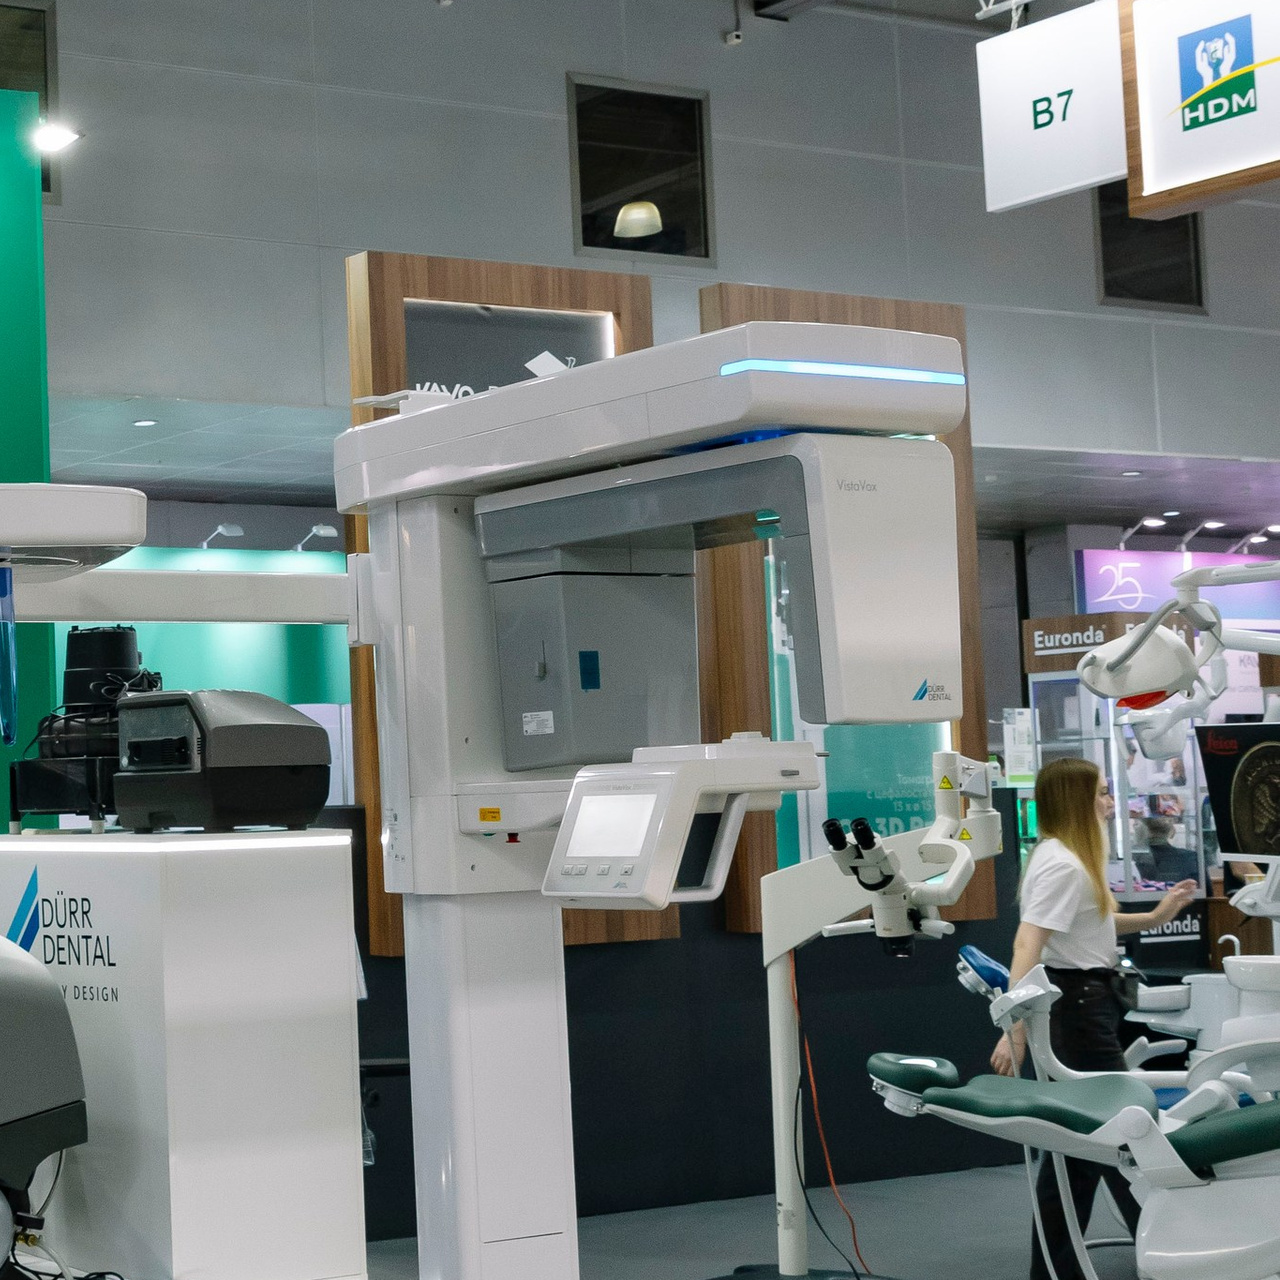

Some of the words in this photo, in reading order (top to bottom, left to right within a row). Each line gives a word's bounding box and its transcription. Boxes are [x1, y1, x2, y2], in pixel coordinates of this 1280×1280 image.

[1032, 89, 1074, 130] B7
[1183, 88, 1256, 127] HDM
[1034, 625, 1105, 648] Euronda
[41, 891, 93, 928] DÜRR
[43, 934, 116, 967] DENTAL
[73, 985, 118, 1002] DESIGN
